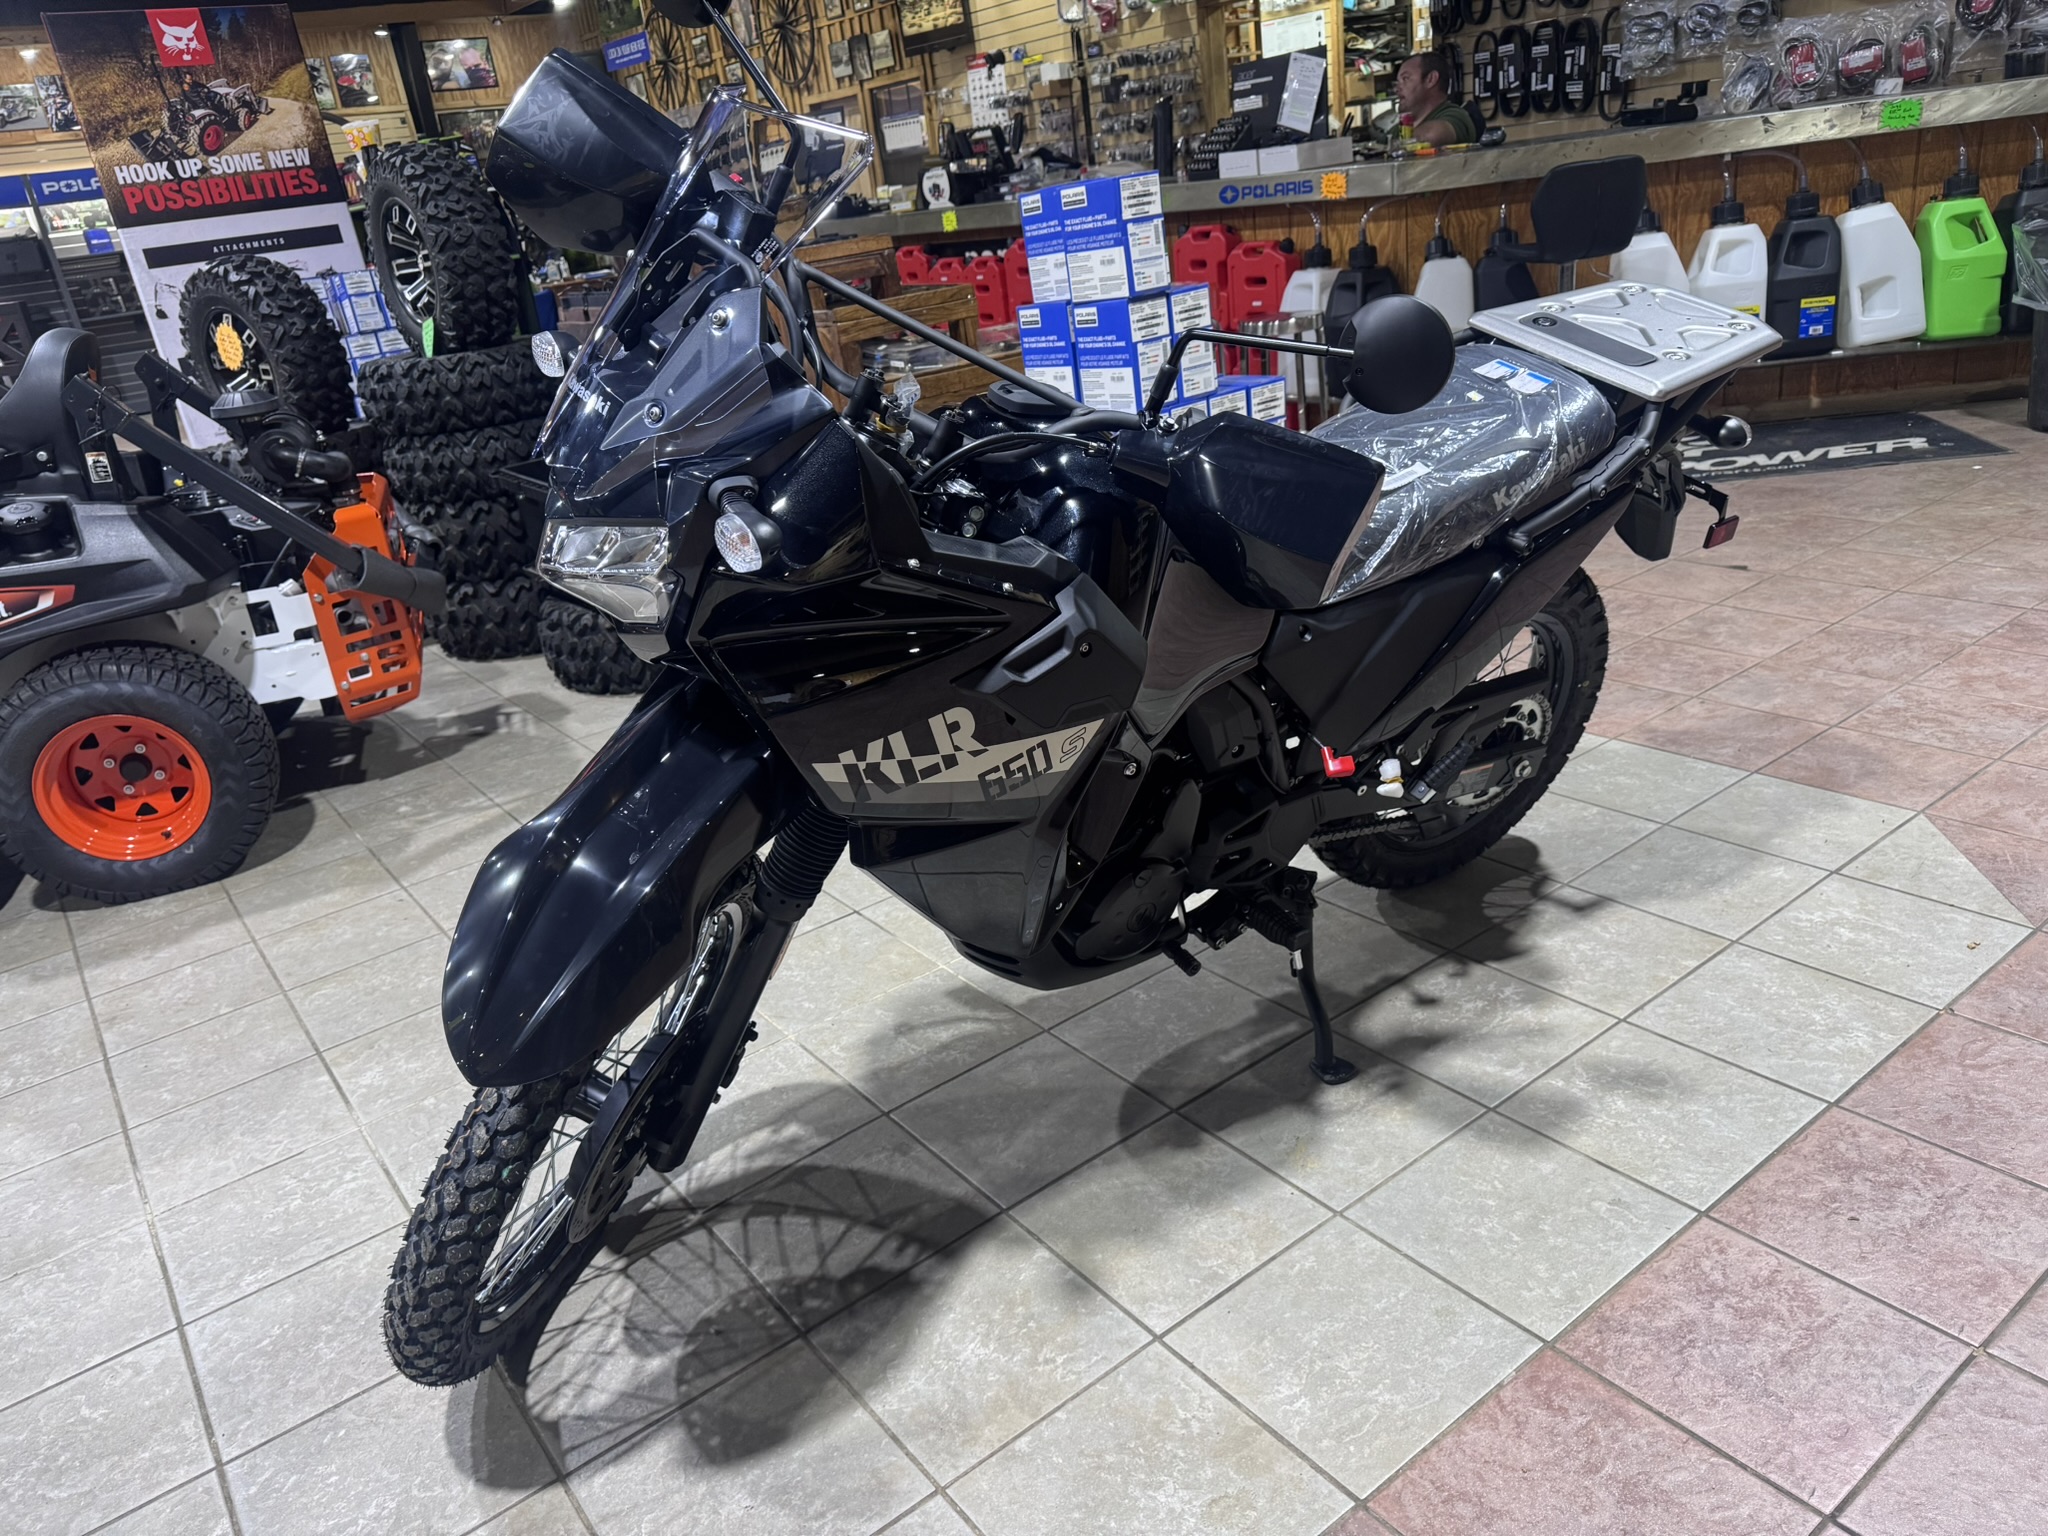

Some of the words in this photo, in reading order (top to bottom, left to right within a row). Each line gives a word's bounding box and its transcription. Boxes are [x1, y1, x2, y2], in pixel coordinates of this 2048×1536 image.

[1237, 69, 1256, 81] acer
[114, 160, 174, 185] HOOK
[175, 157, 204, 180] UP
[210, 153, 264, 176] SOME
[269, 147, 311, 169] NEW
[122, 168, 328, 215] POSSIBILITIES.
[1062, 191, 1085, 200] POLARIS
[1241, 180, 1314, 200] POLARIS
[1022, 198, 1040, 207] POLARIS
[213, 237, 285, 254] ATTACHMENTS
[1492, 436, 1586, 512] Kawsaki
[1690, 463, 1806, 478] erparts.com
[837, 706, 989, 803] KLR
[977, 739, 1054, 801] 650
[1059, 727, 1087, 763] S
